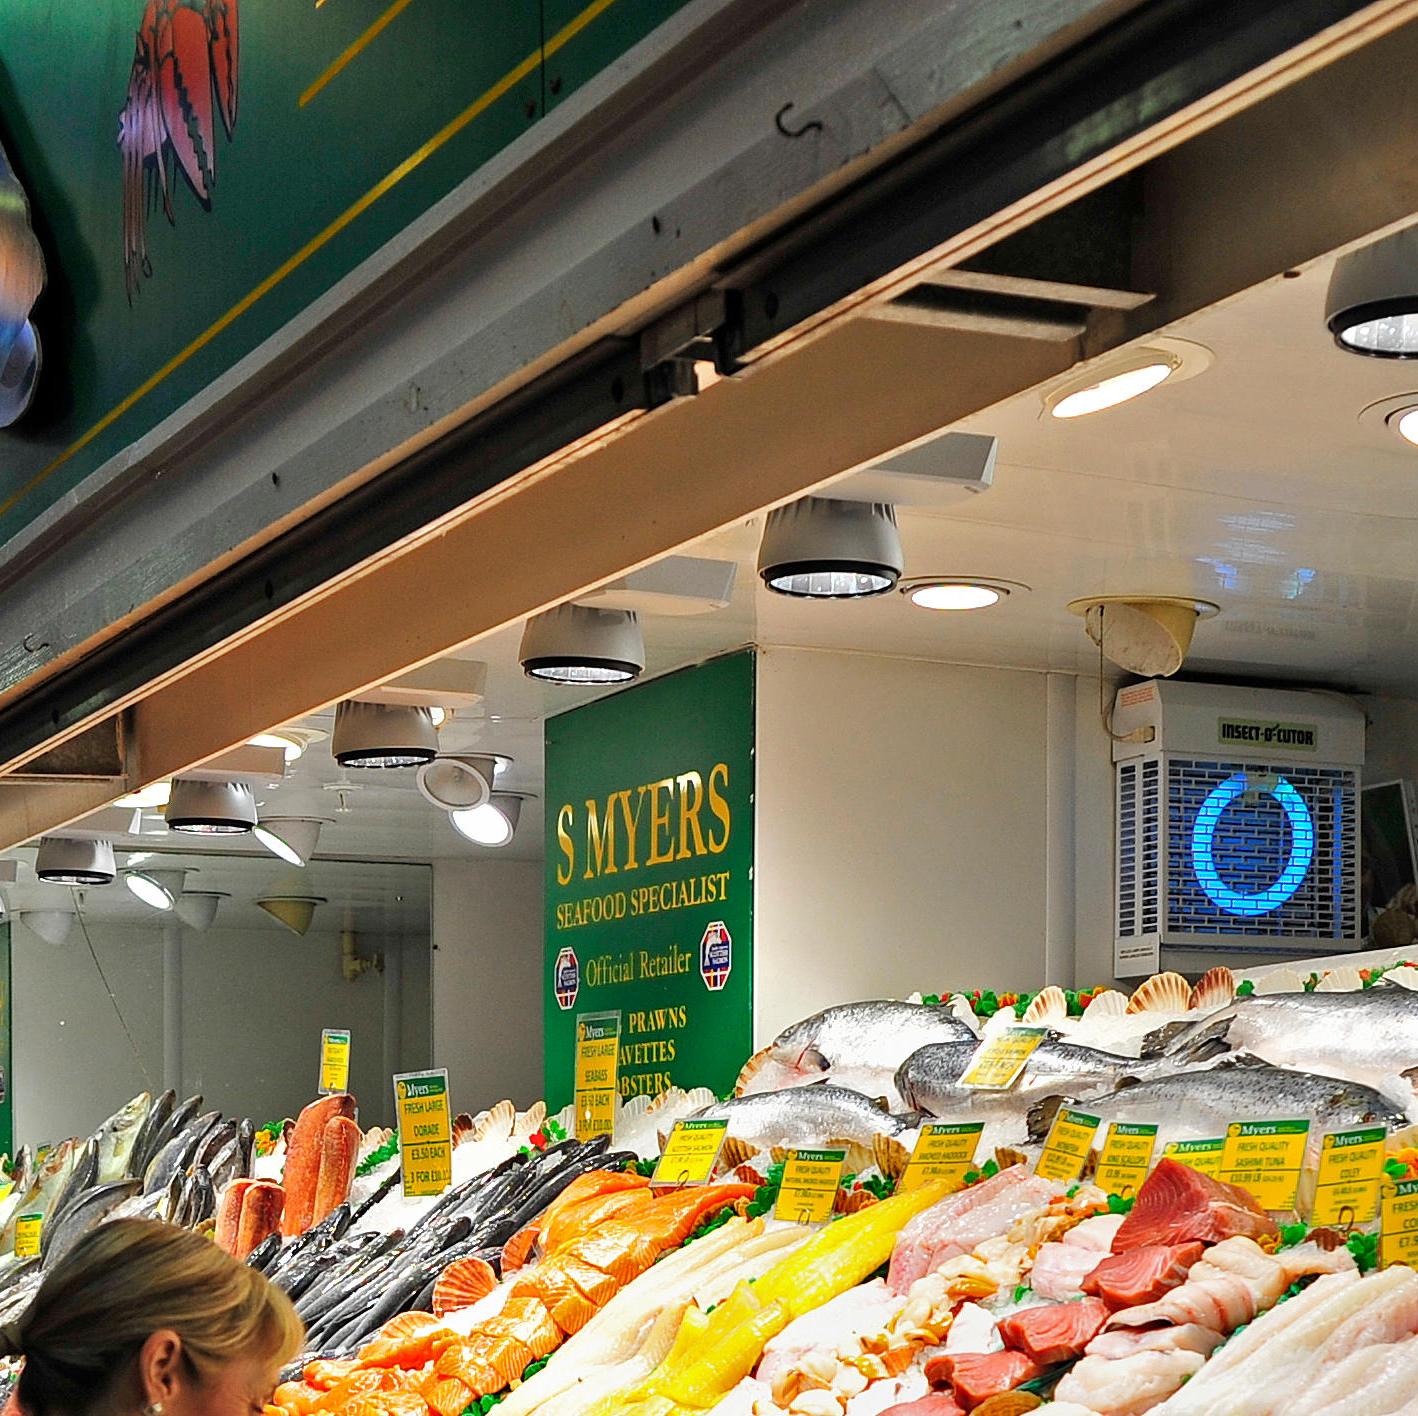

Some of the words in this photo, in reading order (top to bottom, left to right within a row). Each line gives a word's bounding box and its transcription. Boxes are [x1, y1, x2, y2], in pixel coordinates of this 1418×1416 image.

[557, 803, 575, 886] S
[583, 763, 730, 880] MYERS
[556, 891, 627, 930] SEAFOOD
[630, 870, 730, 917] SPECIALIST
[585, 951, 634, 988] Official
[639, 944, 692, 979] Retailer
[628, 1005, 687, 1034] PRAWNS
[585, 1024, 605, 1040] Myers
[618, 1039, 676, 1067] AVETTES
[407, 1083, 430, 1098] Myers
[404, 1101, 424, 1115] FRESH
[425, 1099, 444, 1113] LARGE
[413, 1123, 440, 1137] DORADE
[684, 1122, 708, 1131] Myers
[932, 1126, 960, 1135] Myers
[1117, 1125, 1139, 1135] Myers
[1241, 1124, 1277, 1136] Myers
[1237, 1142, 1258, 1151] FRESH
[1259, 1141, 1290, 1152] QUALITY
[1335, 1134, 1363, 1146] Myers
[431, 1147, 446, 1160] EACH
[1178, 1142, 1212, 1153] Myers
[798, 1151, 824, 1161] Myers
[1235, 1157, 1263, 1168] SASHIMI
[1265, 1157, 1285, 1167] TUNA
[1328, 1151, 1348, 1164] FRESH
[1349, 1149, 1377, 1163] QUALITY
[416, 1170, 430, 1183] FOR
